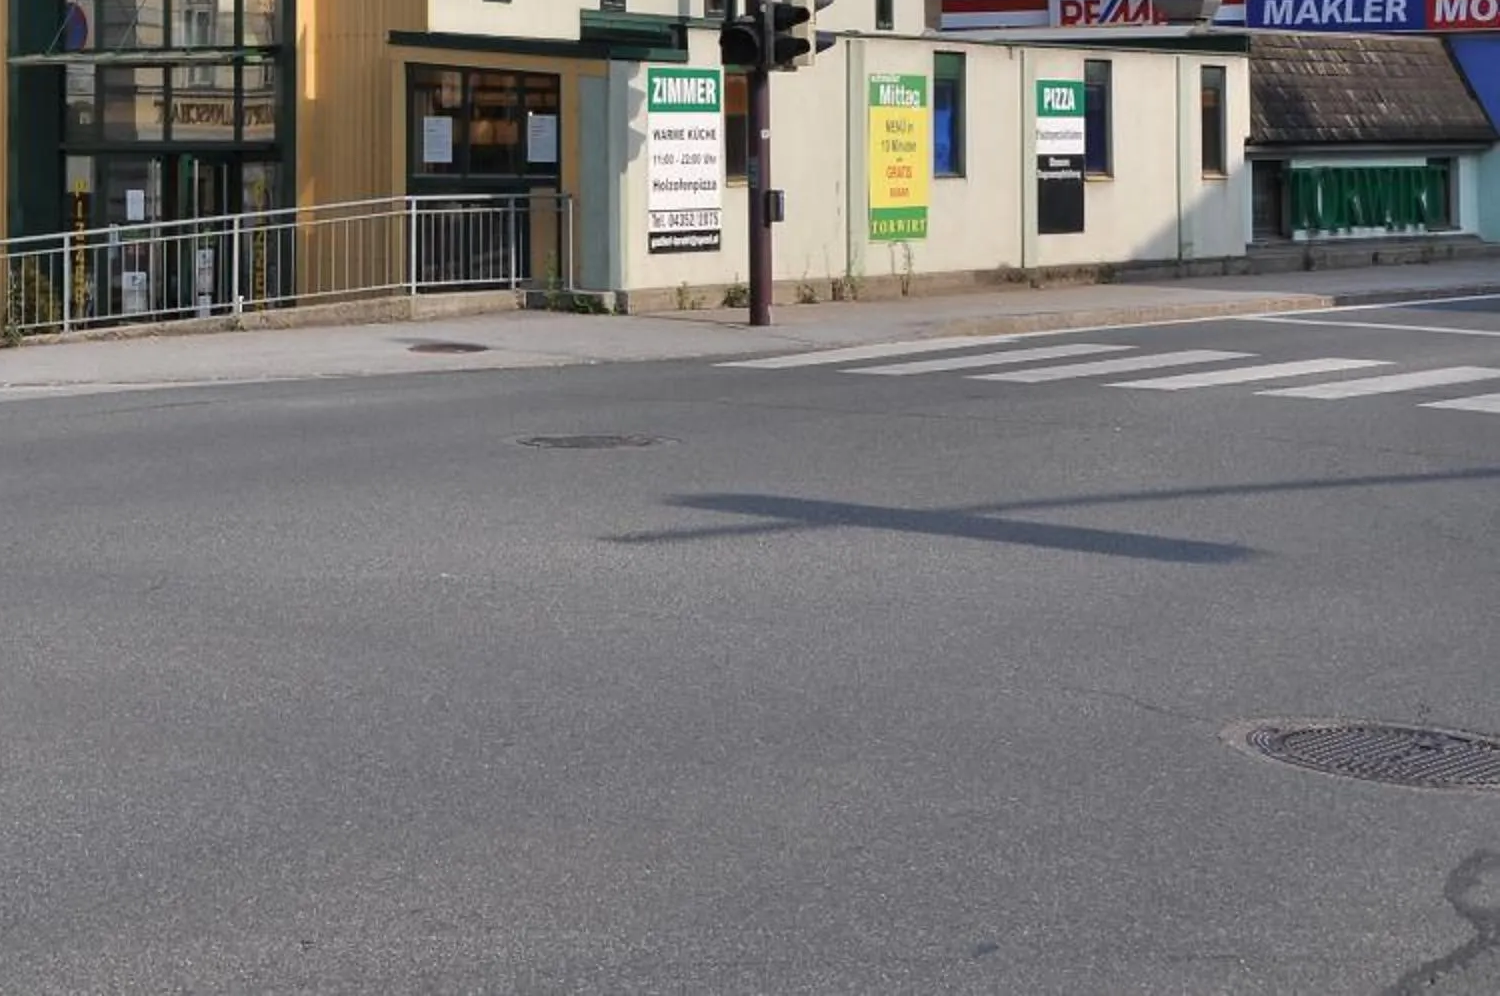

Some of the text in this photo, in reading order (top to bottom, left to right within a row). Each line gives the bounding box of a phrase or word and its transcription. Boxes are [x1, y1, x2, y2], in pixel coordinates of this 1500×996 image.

[652, 77, 717, 104] ZIMMER
[879, 83, 920, 110] Mittag
[1043, 87, 1076, 111] PIZZA
[653, 126, 717, 140] WARME KÜCHE
[872, 219, 925, 235] TORWIRT
